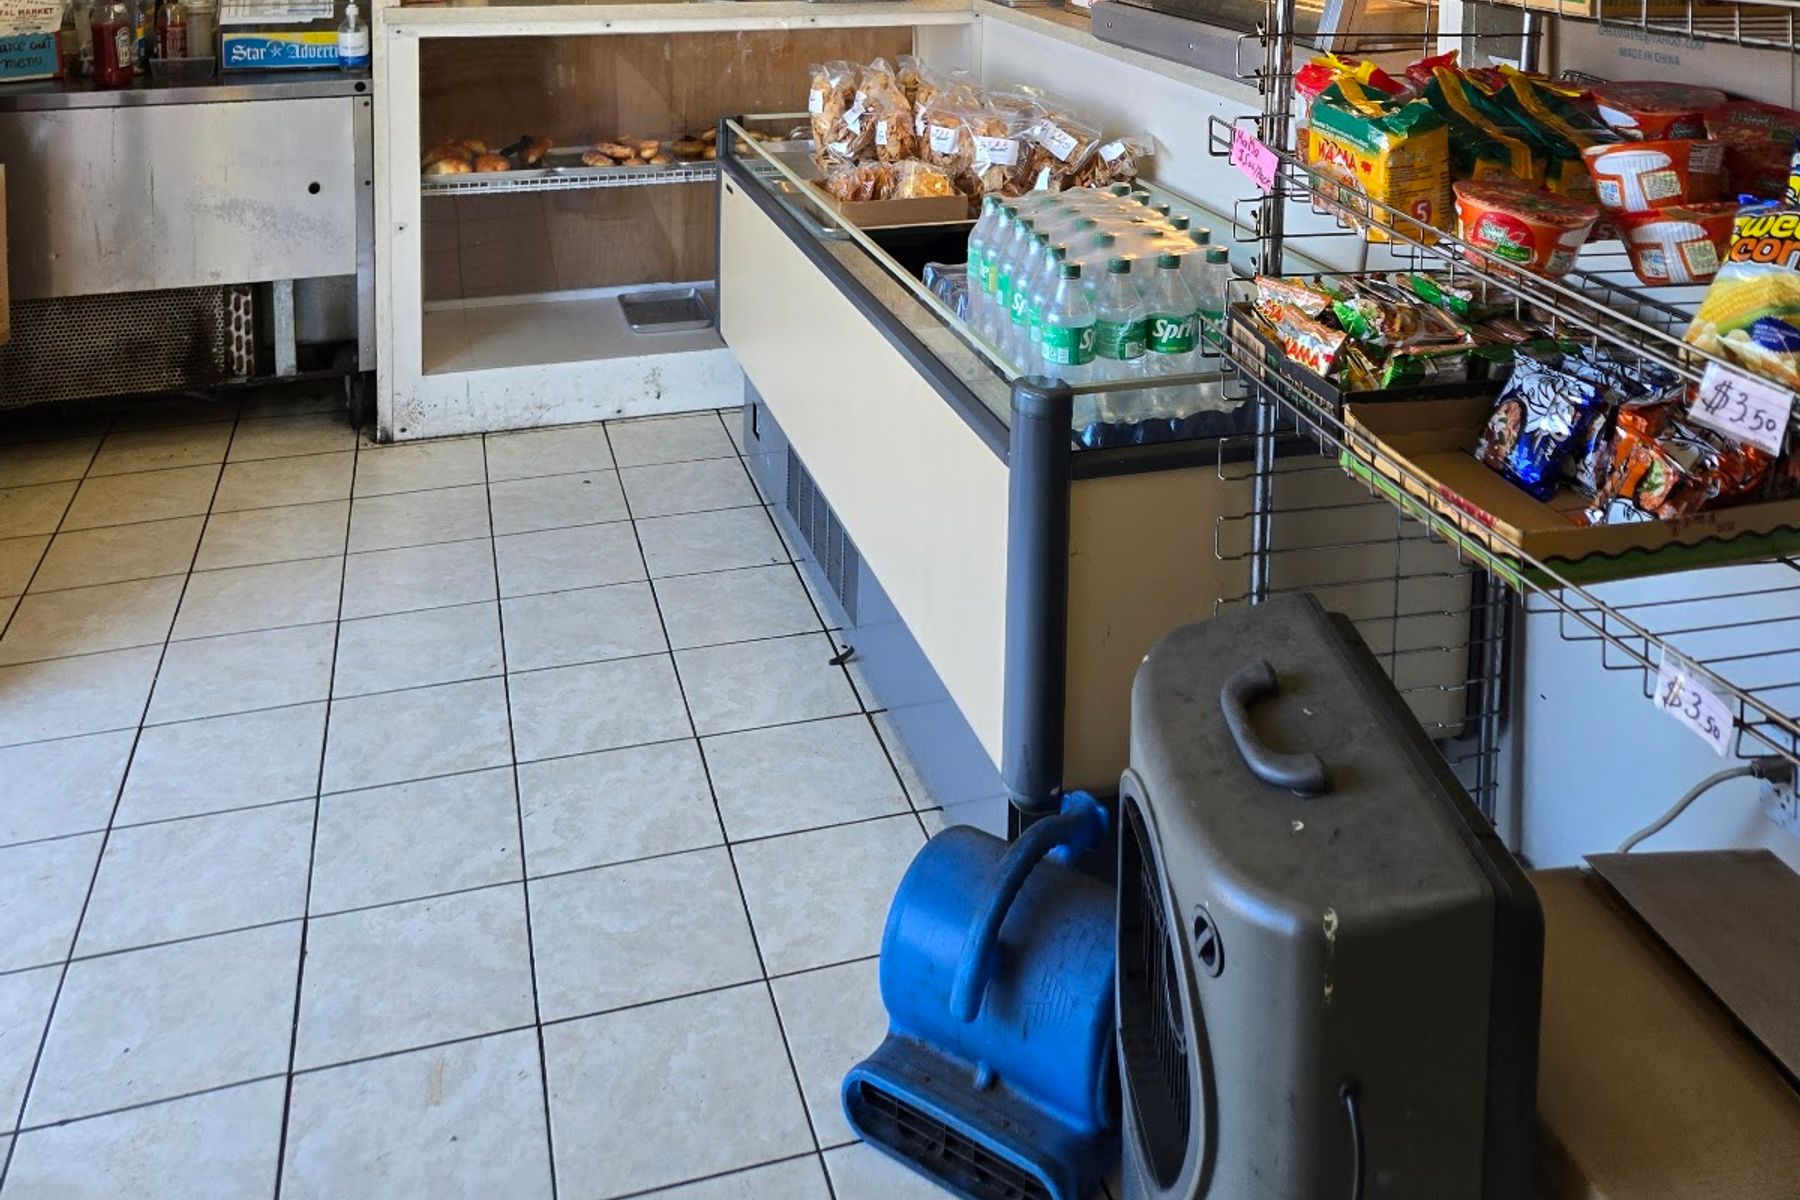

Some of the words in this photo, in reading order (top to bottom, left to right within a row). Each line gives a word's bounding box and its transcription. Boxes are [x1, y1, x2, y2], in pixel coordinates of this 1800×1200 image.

[231, 45, 266, 62] Star
[1619, 47, 1641, 59] MADE
[1643, 50, 1653, 61] IN
[1655, 53, 1680, 66] CHINA
